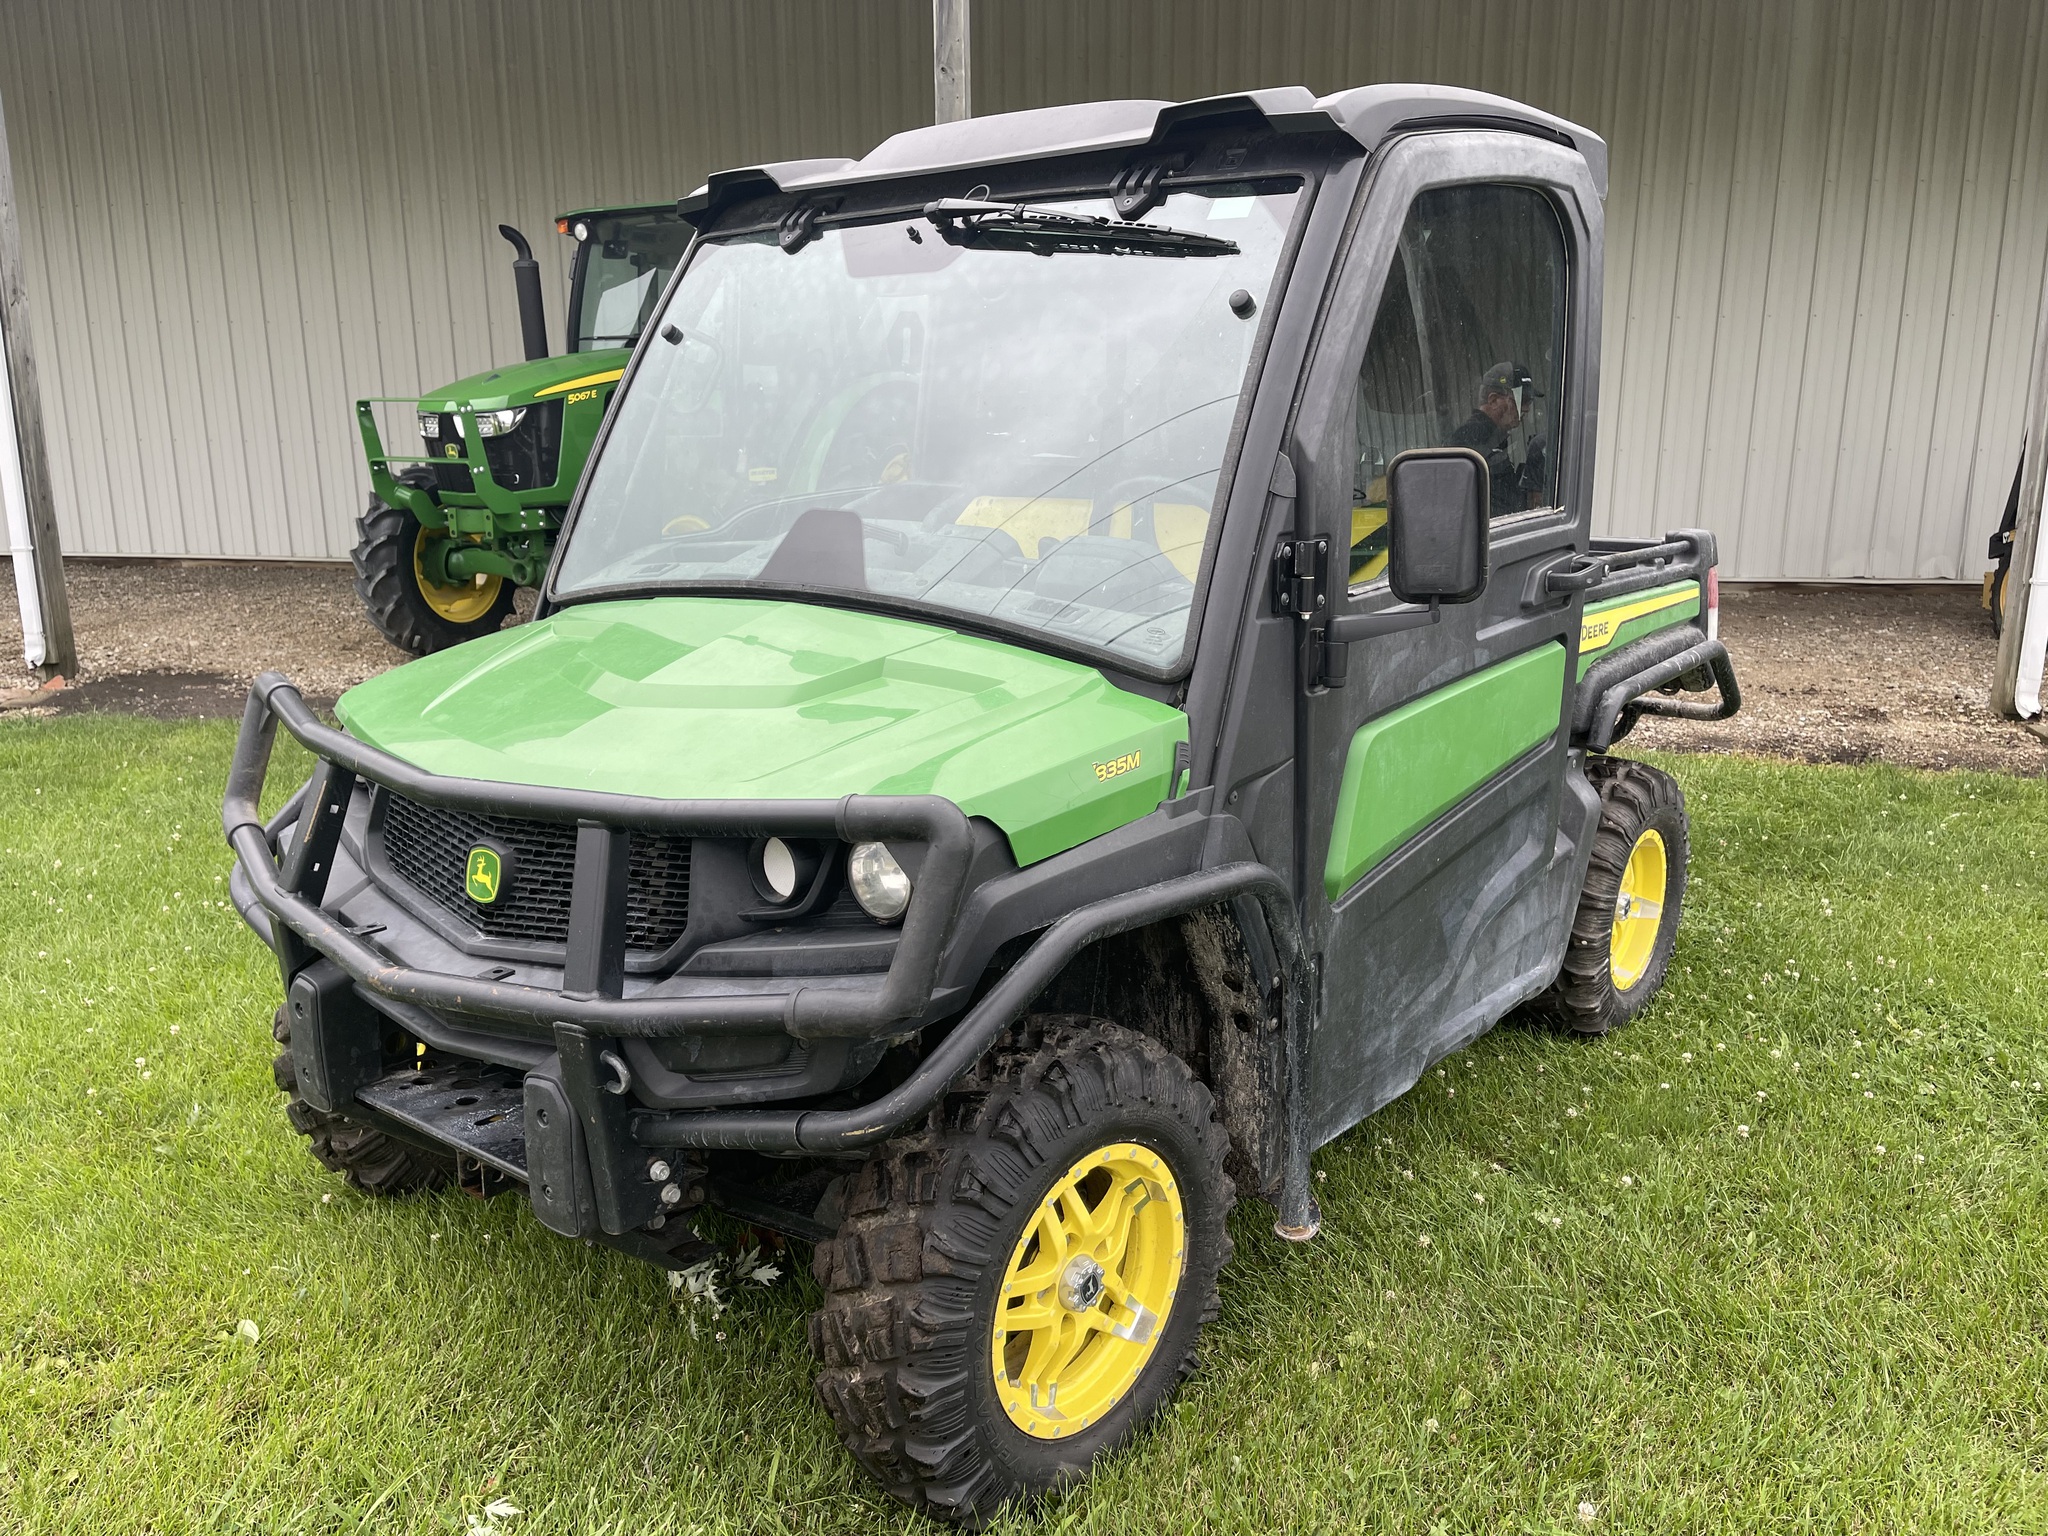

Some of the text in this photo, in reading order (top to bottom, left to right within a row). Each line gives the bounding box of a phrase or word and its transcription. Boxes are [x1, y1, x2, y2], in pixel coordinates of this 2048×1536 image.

[568, 389, 597, 404] 5067 E
[1581, 621, 1609, 641] DEERE
[1092, 750, 1141, 782] 835M
